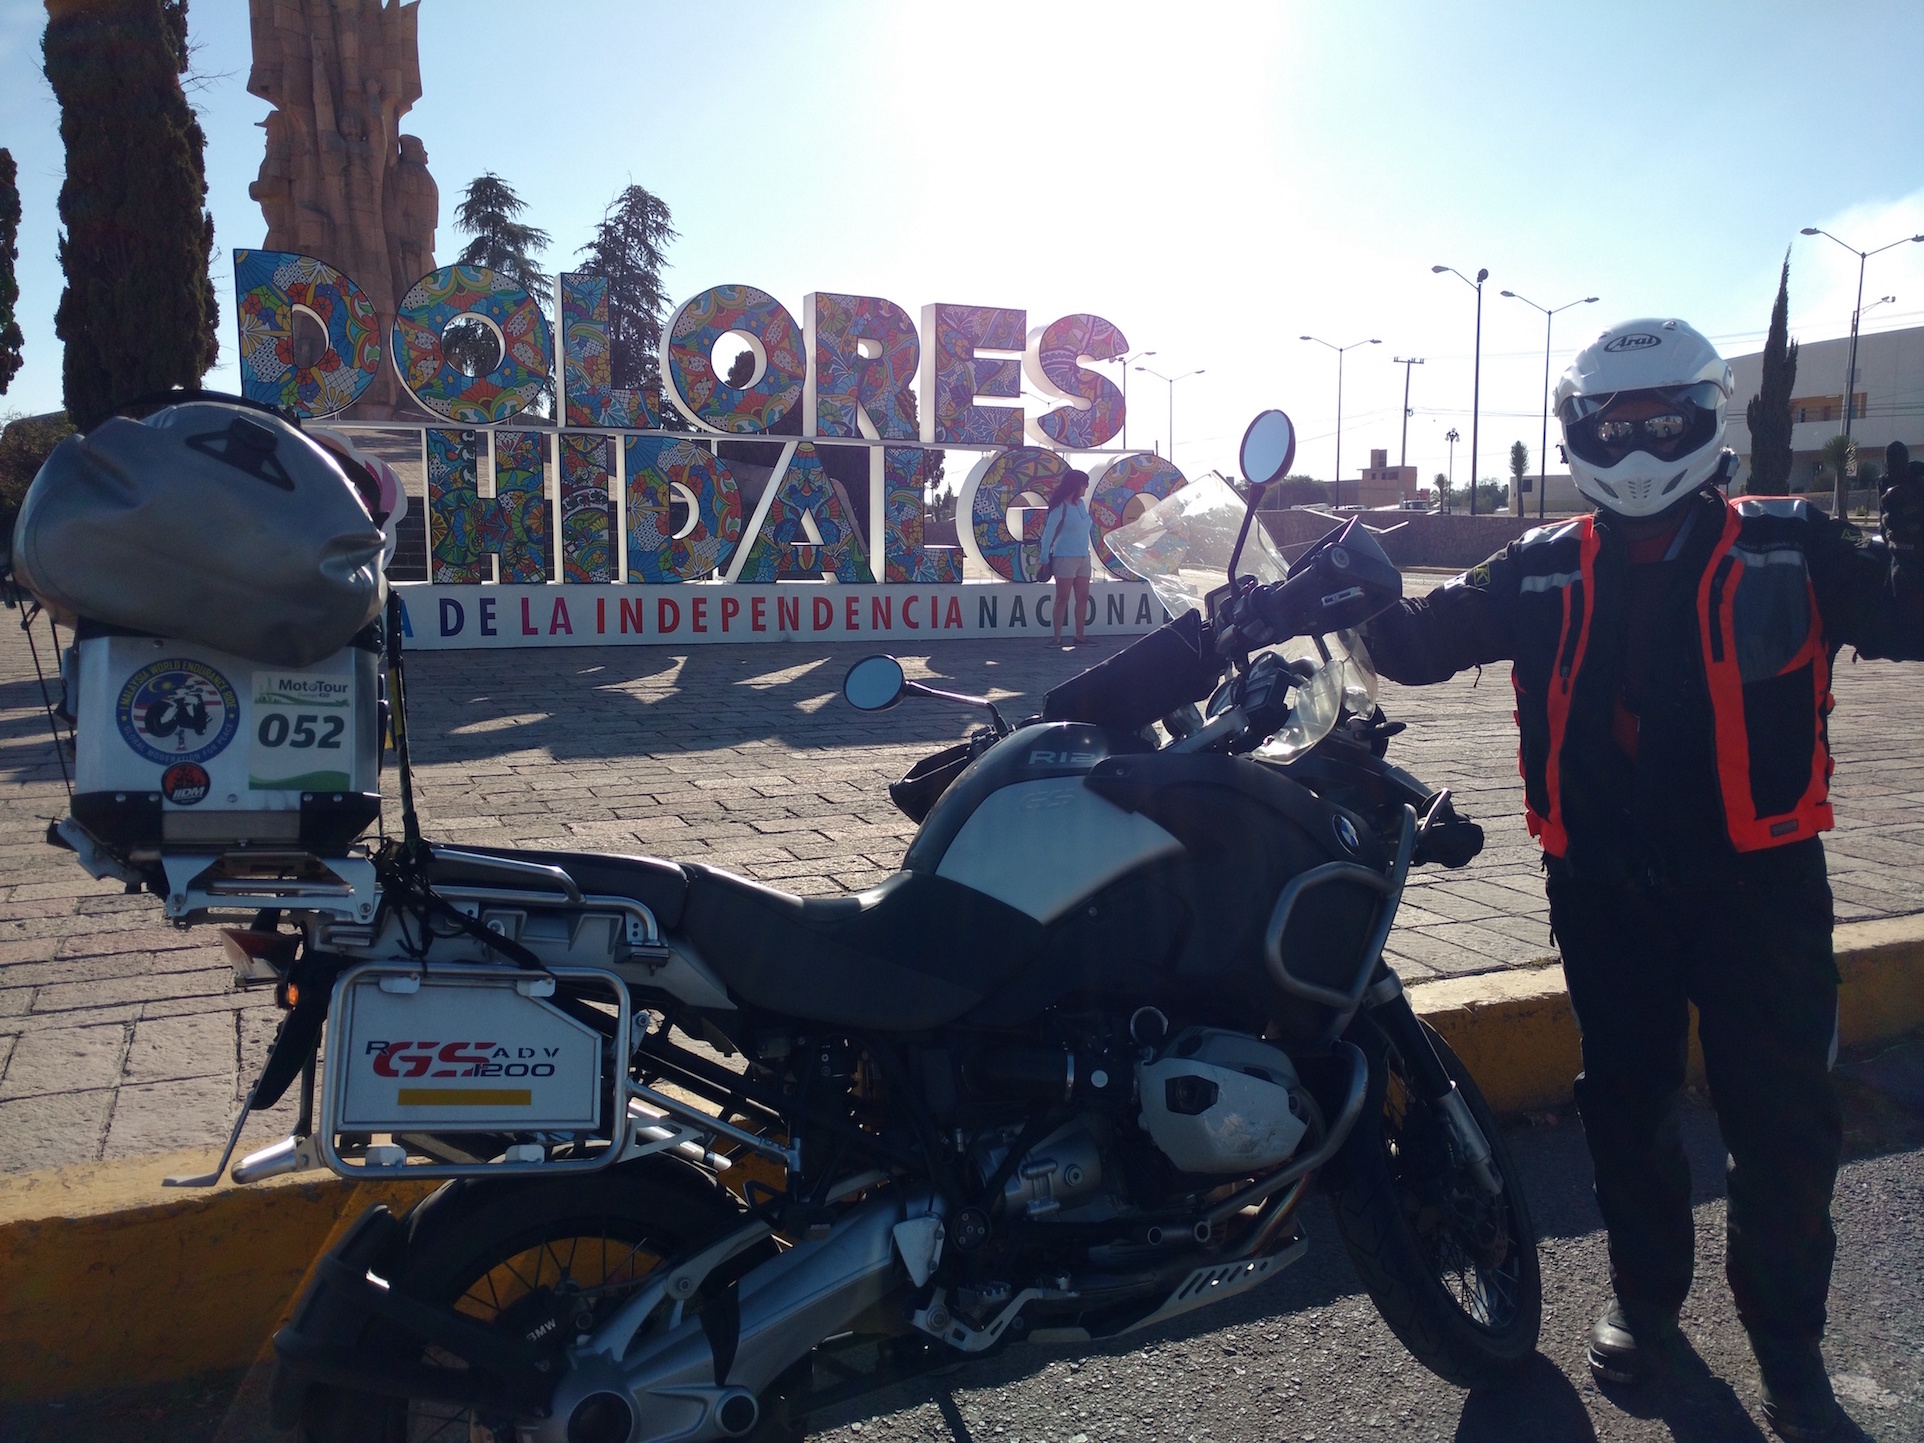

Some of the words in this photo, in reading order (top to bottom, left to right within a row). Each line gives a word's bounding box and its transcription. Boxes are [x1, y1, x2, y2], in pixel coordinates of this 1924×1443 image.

[233, 248, 1130, 452] DOLORES
[424, 428, 1188, 583] HIDALGO
[439, 597, 497, 637] DE
[521, 597, 573, 635] LA
[597, 595, 964, 634] INDEPENDENCIA
[149, 660, 180, 675] WORLD
[182, 661, 228, 693] ENDURANCE
[222, 690, 237, 709] RIDE
[279, 679, 348, 693] MotoTour
[258, 713, 345, 749] 052
[373, 1041, 497, 1077] GS
[492, 1047, 560, 1058] ADV
[472, 1063, 555, 1077] 1200
[526, 1318, 557, 1342] BMW
